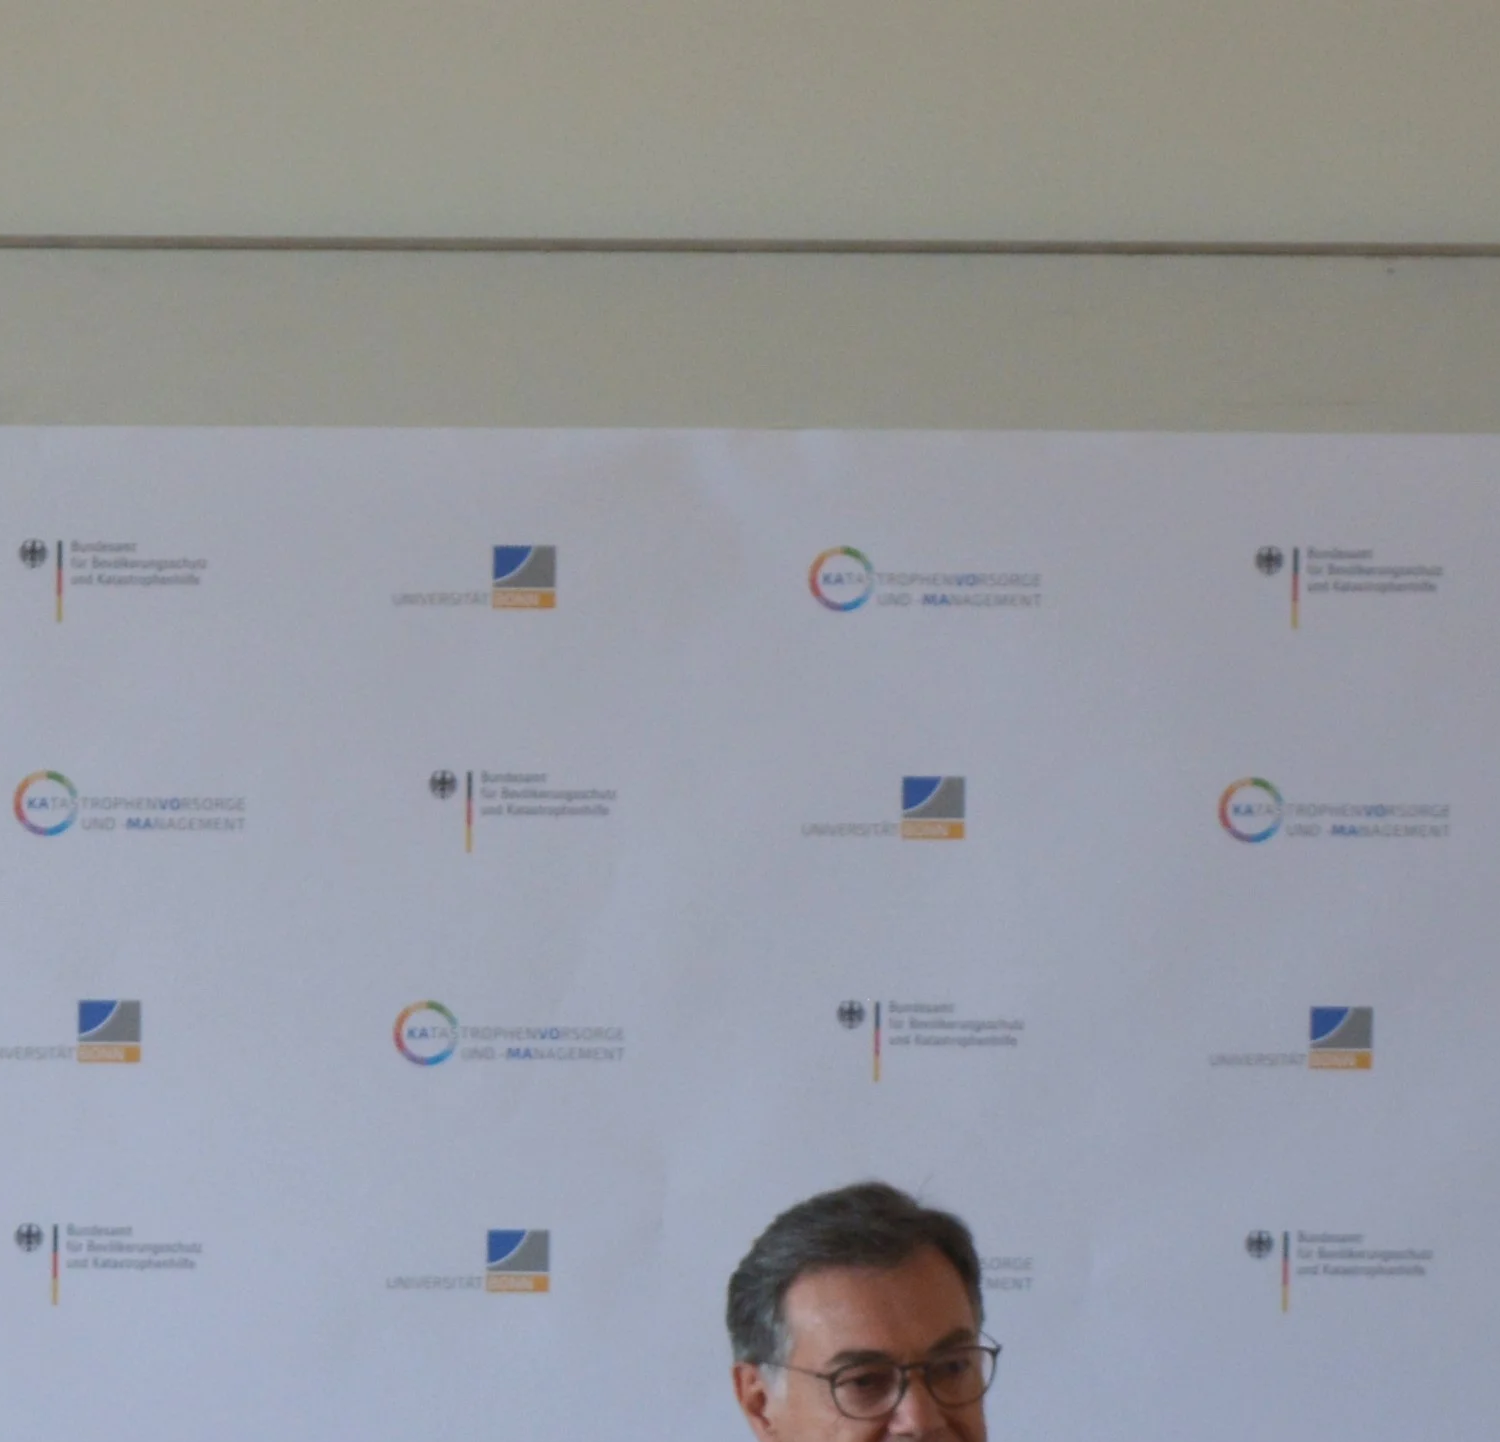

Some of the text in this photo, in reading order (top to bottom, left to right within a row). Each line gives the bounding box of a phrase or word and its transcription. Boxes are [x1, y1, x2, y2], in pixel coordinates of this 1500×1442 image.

[71, 573, 93, 585] und
[82, 818, 115, 832] UND
[66, 1257, 88, 1269] und
